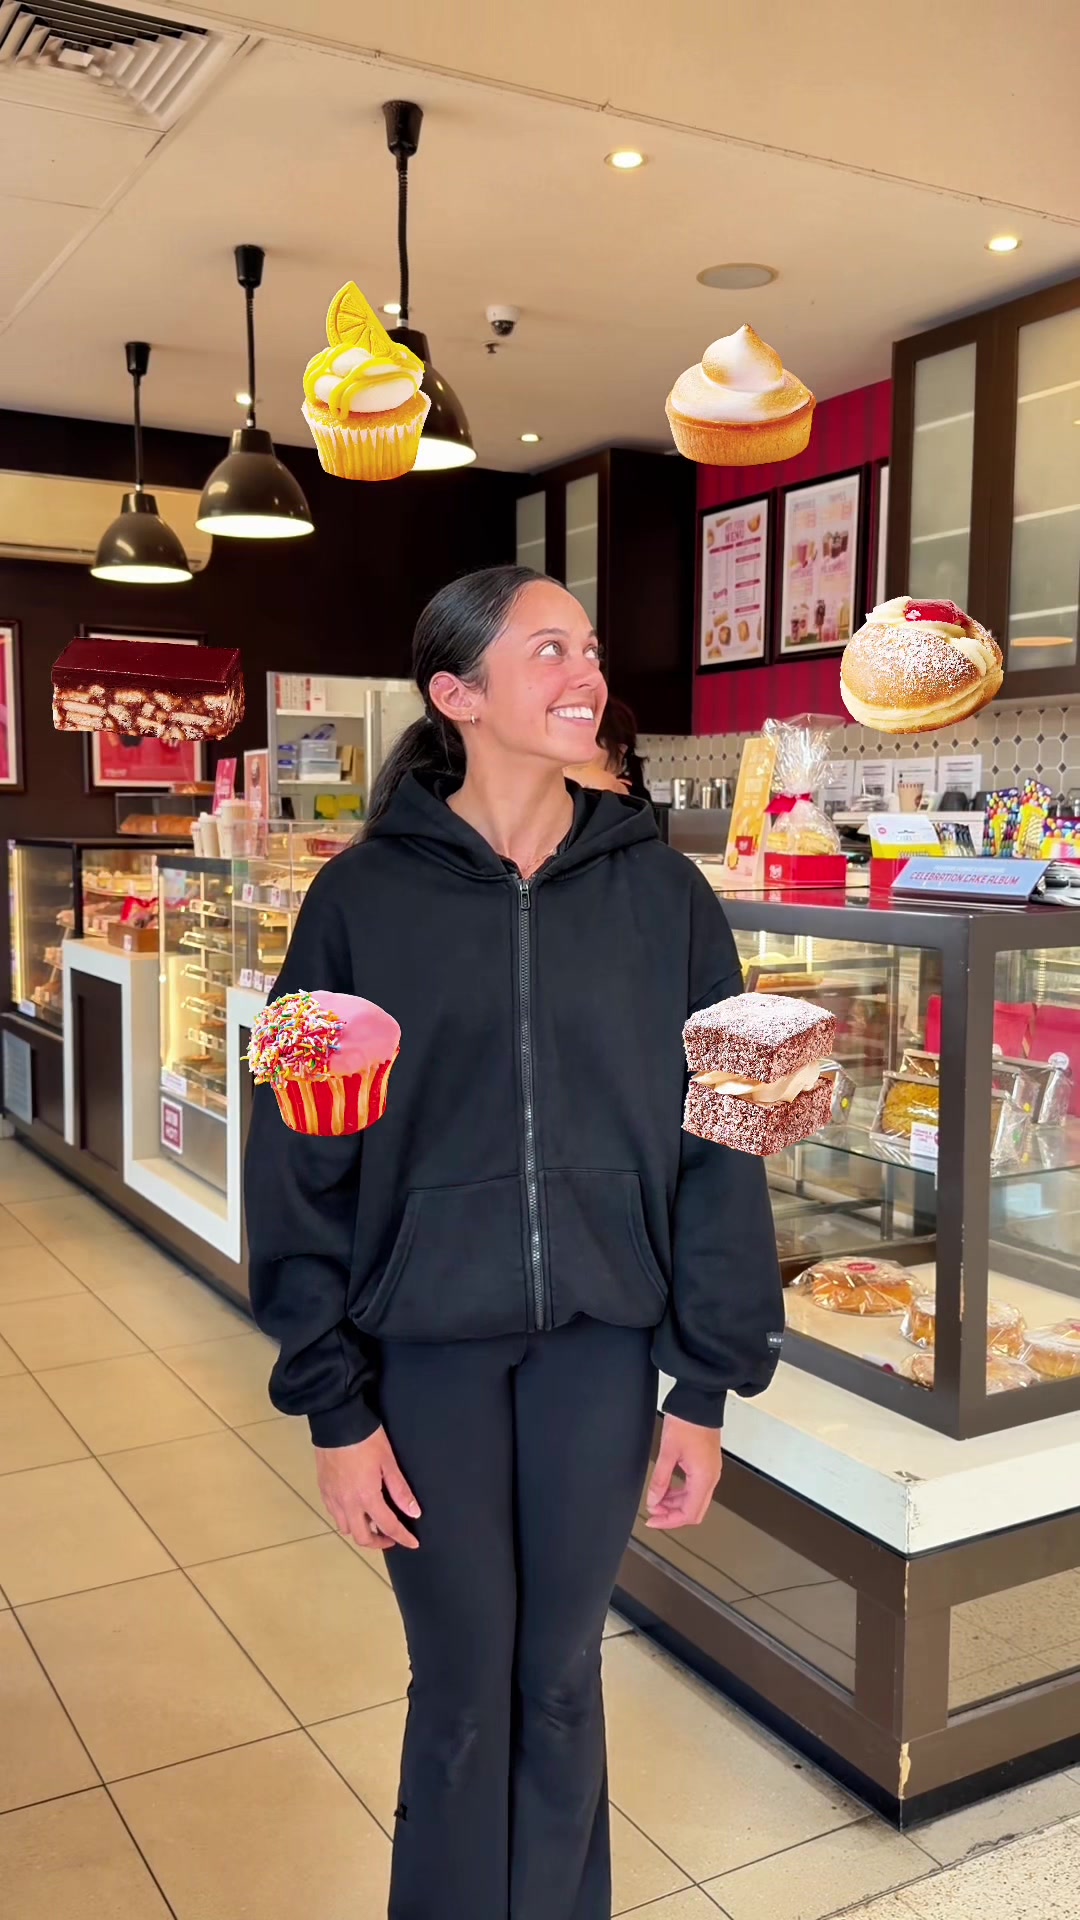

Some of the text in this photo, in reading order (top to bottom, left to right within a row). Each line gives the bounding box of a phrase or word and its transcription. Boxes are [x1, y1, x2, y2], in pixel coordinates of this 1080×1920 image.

[725, 528, 745, 543] MENU
[909, 871, 1020, 885] CELEBRATION CAKE ALBUM
